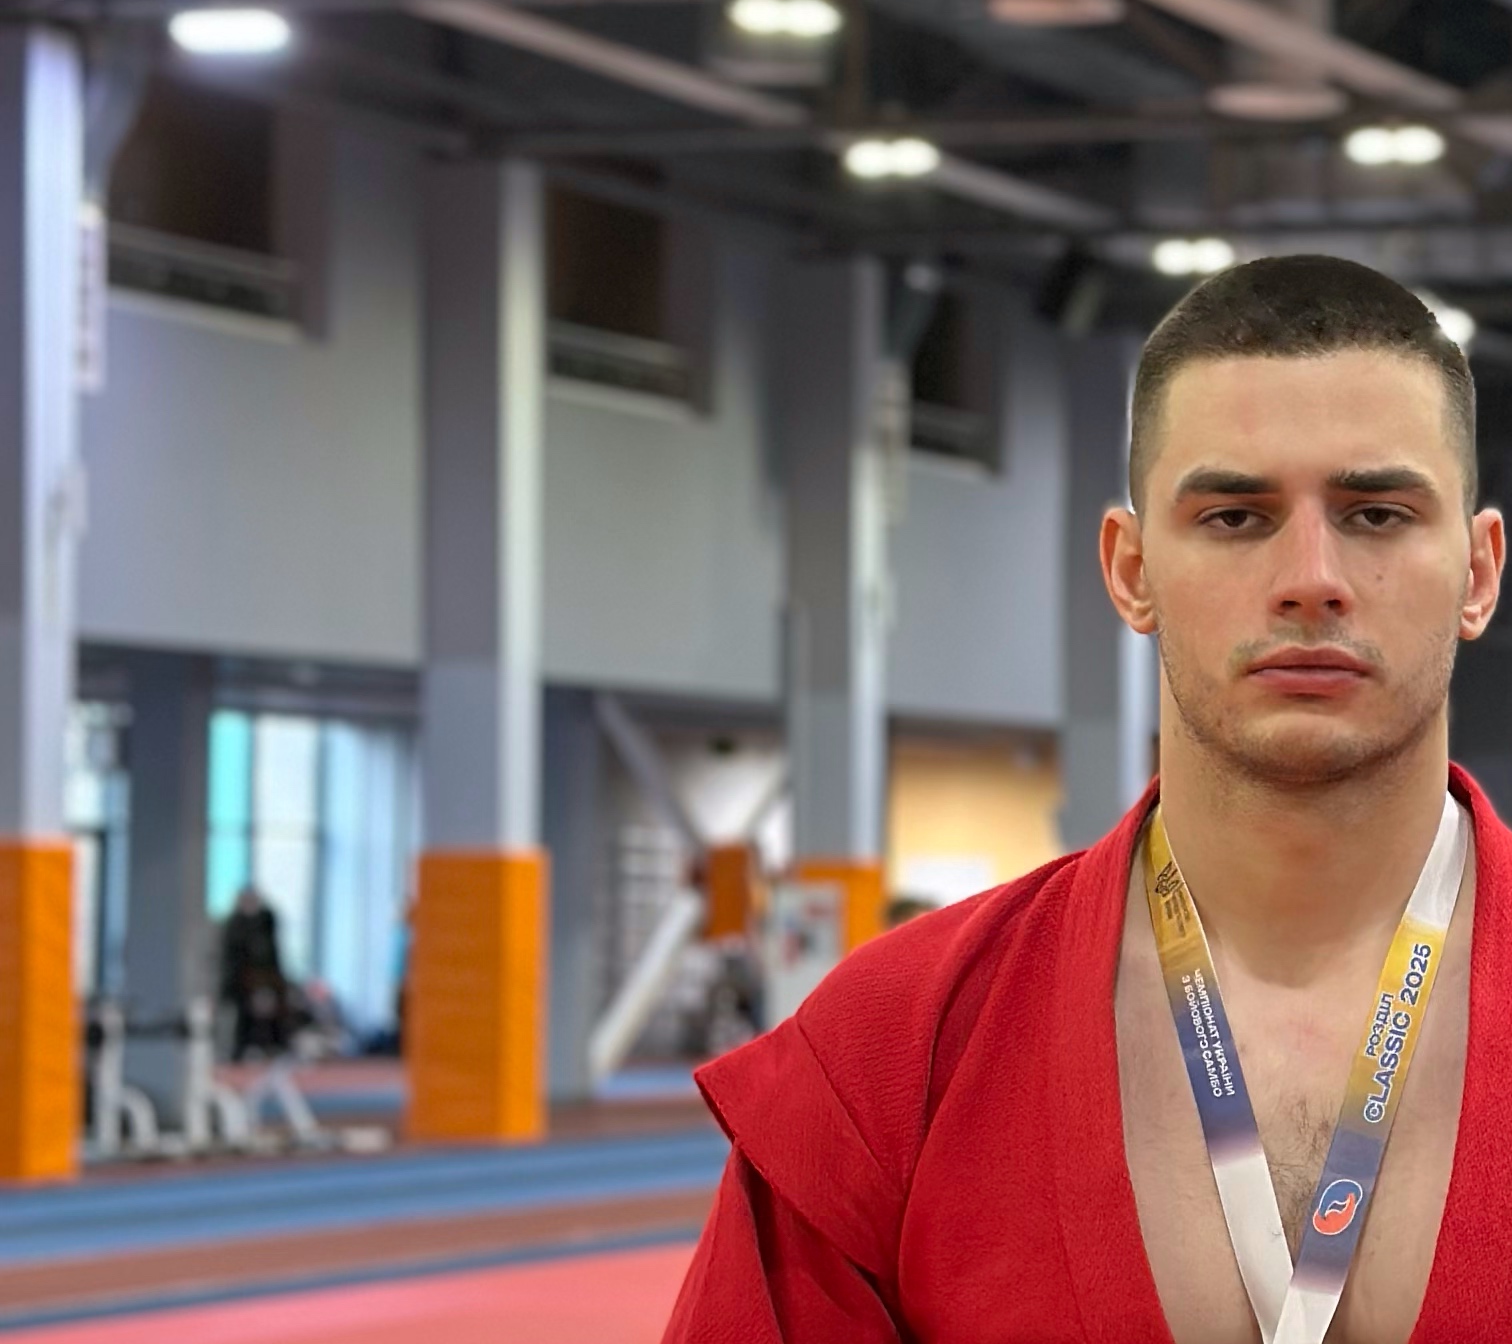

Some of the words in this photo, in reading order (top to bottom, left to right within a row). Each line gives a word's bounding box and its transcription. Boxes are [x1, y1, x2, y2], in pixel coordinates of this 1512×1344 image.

[1184, 984, 1208, 1049] БОЙОВОГО
[1202, 1050, 1223, 1098] САМБО
[1194, 968, 1220, 1039] ЧЕМПІОНАТ
[1212, 1040, 1236, 1096] УКРАЇНИ
[1364, 1012, 1411, 1123] CLASSIC
[1400, 943, 1432, 1007] 2025
